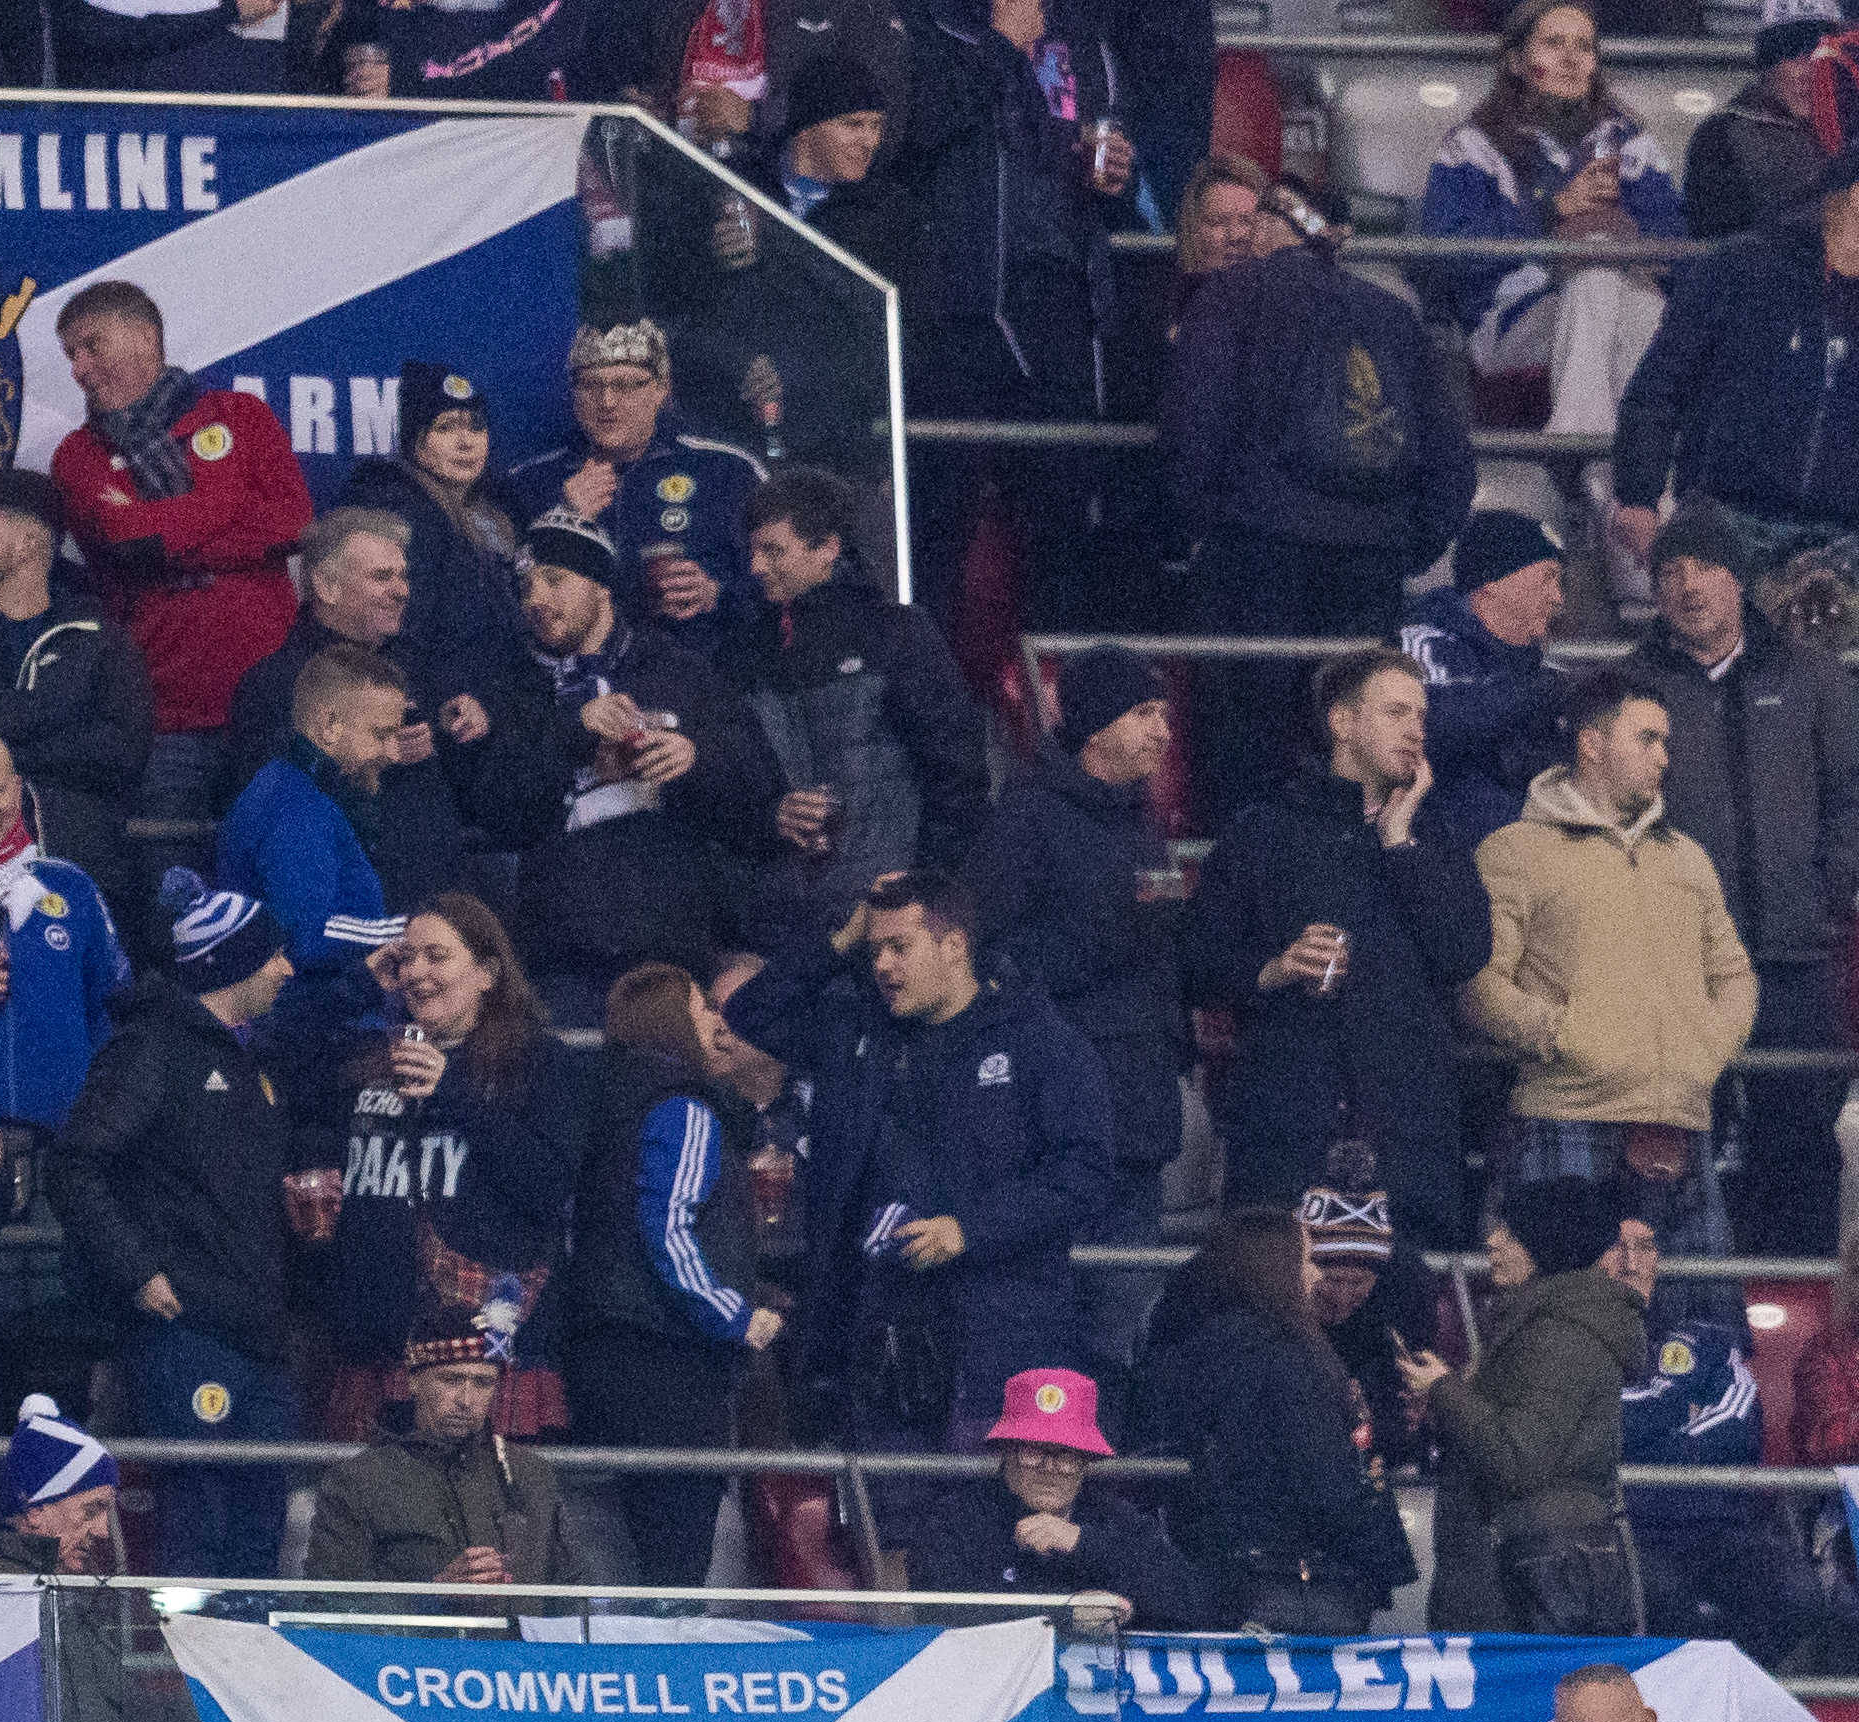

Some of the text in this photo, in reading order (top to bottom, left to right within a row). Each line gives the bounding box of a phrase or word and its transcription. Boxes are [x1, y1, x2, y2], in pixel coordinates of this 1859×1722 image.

[234, 375, 402, 457] ARM
[377, 1665, 849, 1714] CROMWELL REDS
[1059, 1637, 1476, 1715] CULLEN
